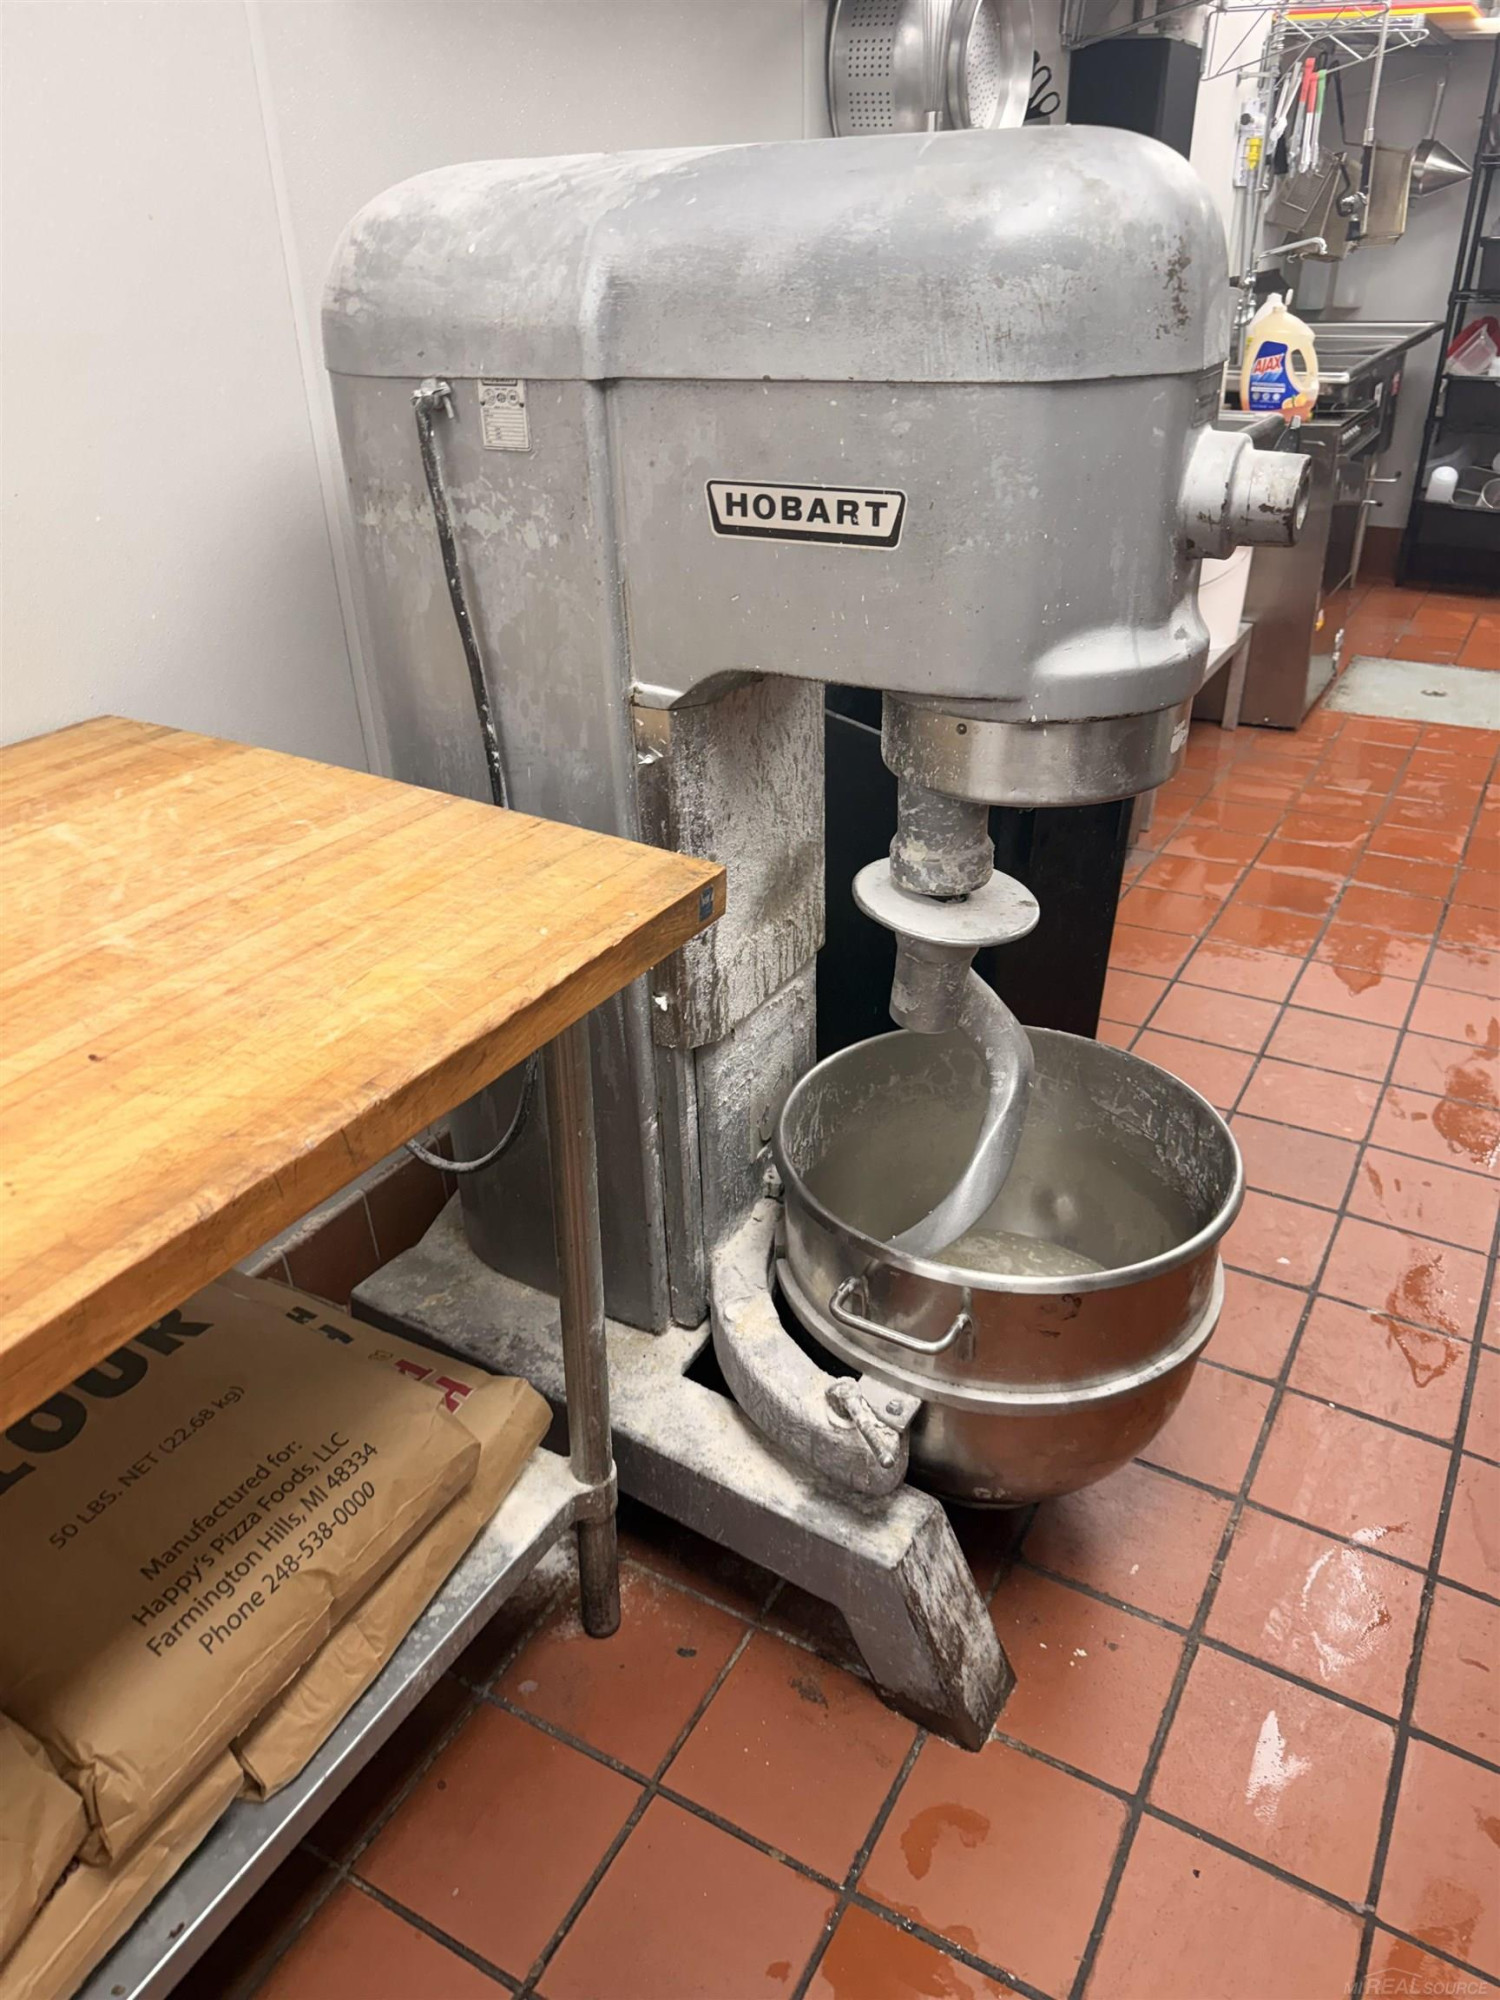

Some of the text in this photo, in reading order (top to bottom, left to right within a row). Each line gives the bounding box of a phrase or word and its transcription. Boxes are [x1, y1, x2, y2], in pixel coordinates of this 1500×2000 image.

[1253, 355, 1283, 374] AJAX
[725, 492, 888, 527] HOBART
[49, 1385, 245, 1549] 50 LBS. NET (22.68 kg)
[131, 1431, 350, 1627] Happy's Pizza Foods, LLC
[140, 1440, 303, 1580] Manufactured for:
[146, 1442, 379, 1657] Farmington Hills, MI 48334
[198, 1480, 375, 1655] Phone 248-538-0000
